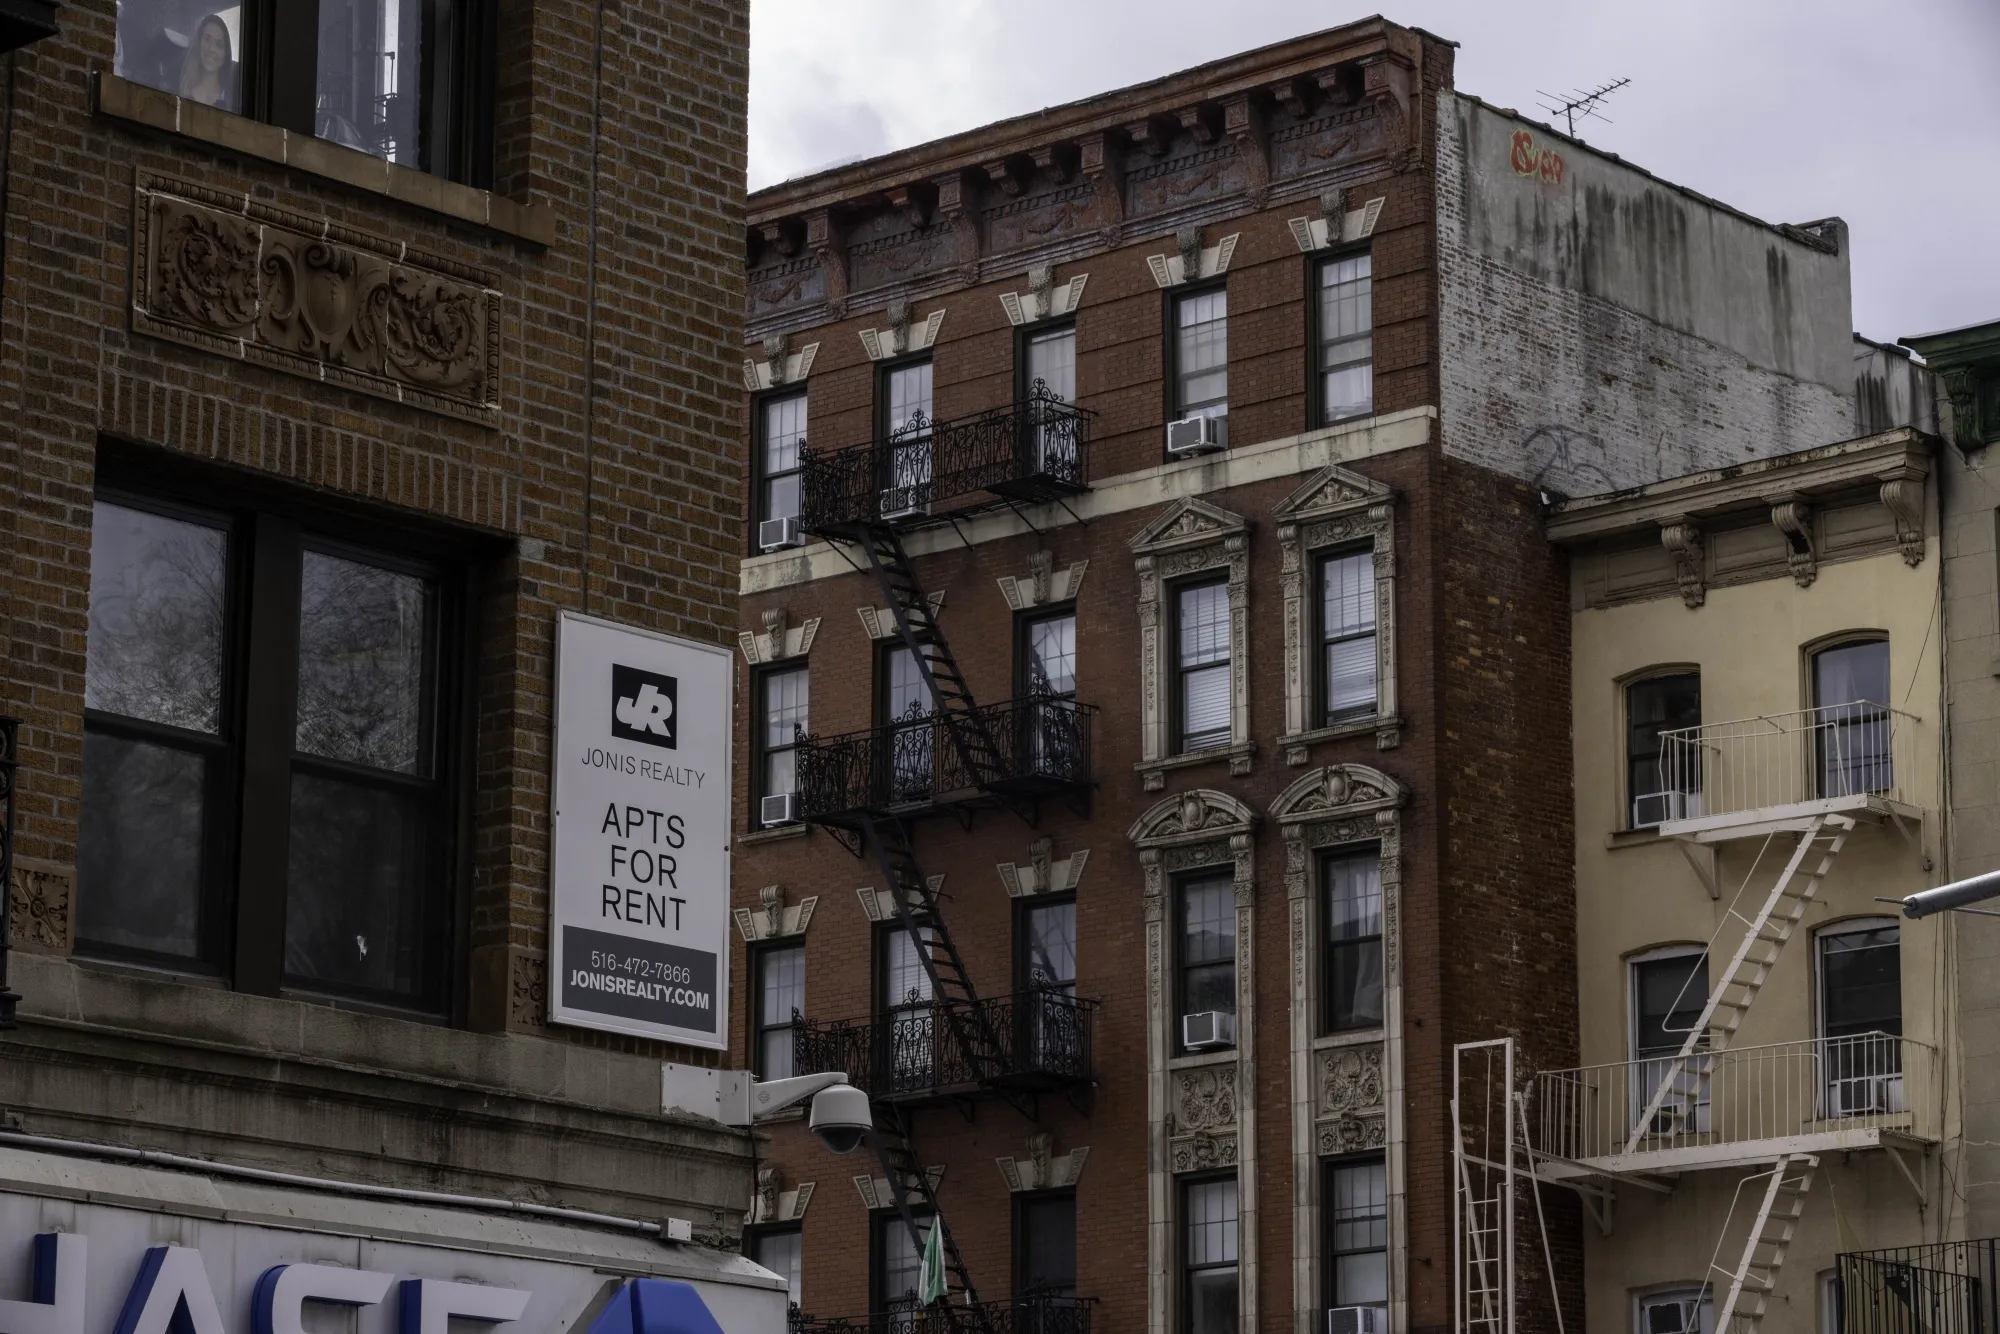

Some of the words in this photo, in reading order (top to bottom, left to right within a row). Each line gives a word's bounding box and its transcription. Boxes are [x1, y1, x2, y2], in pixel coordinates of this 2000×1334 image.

[615, 683, 673, 738] JR
[581, 747, 636, 775] JONIS
[640, 759, 706, 789] REALTY
[601, 802, 685, 849] APTS
[611, 844, 678, 889] FOR
[602, 883, 687, 931] RENT
[570, 969, 709, 1010] JONISREALTY.COM
[591, 950, 691, 985] 516-472-7866
